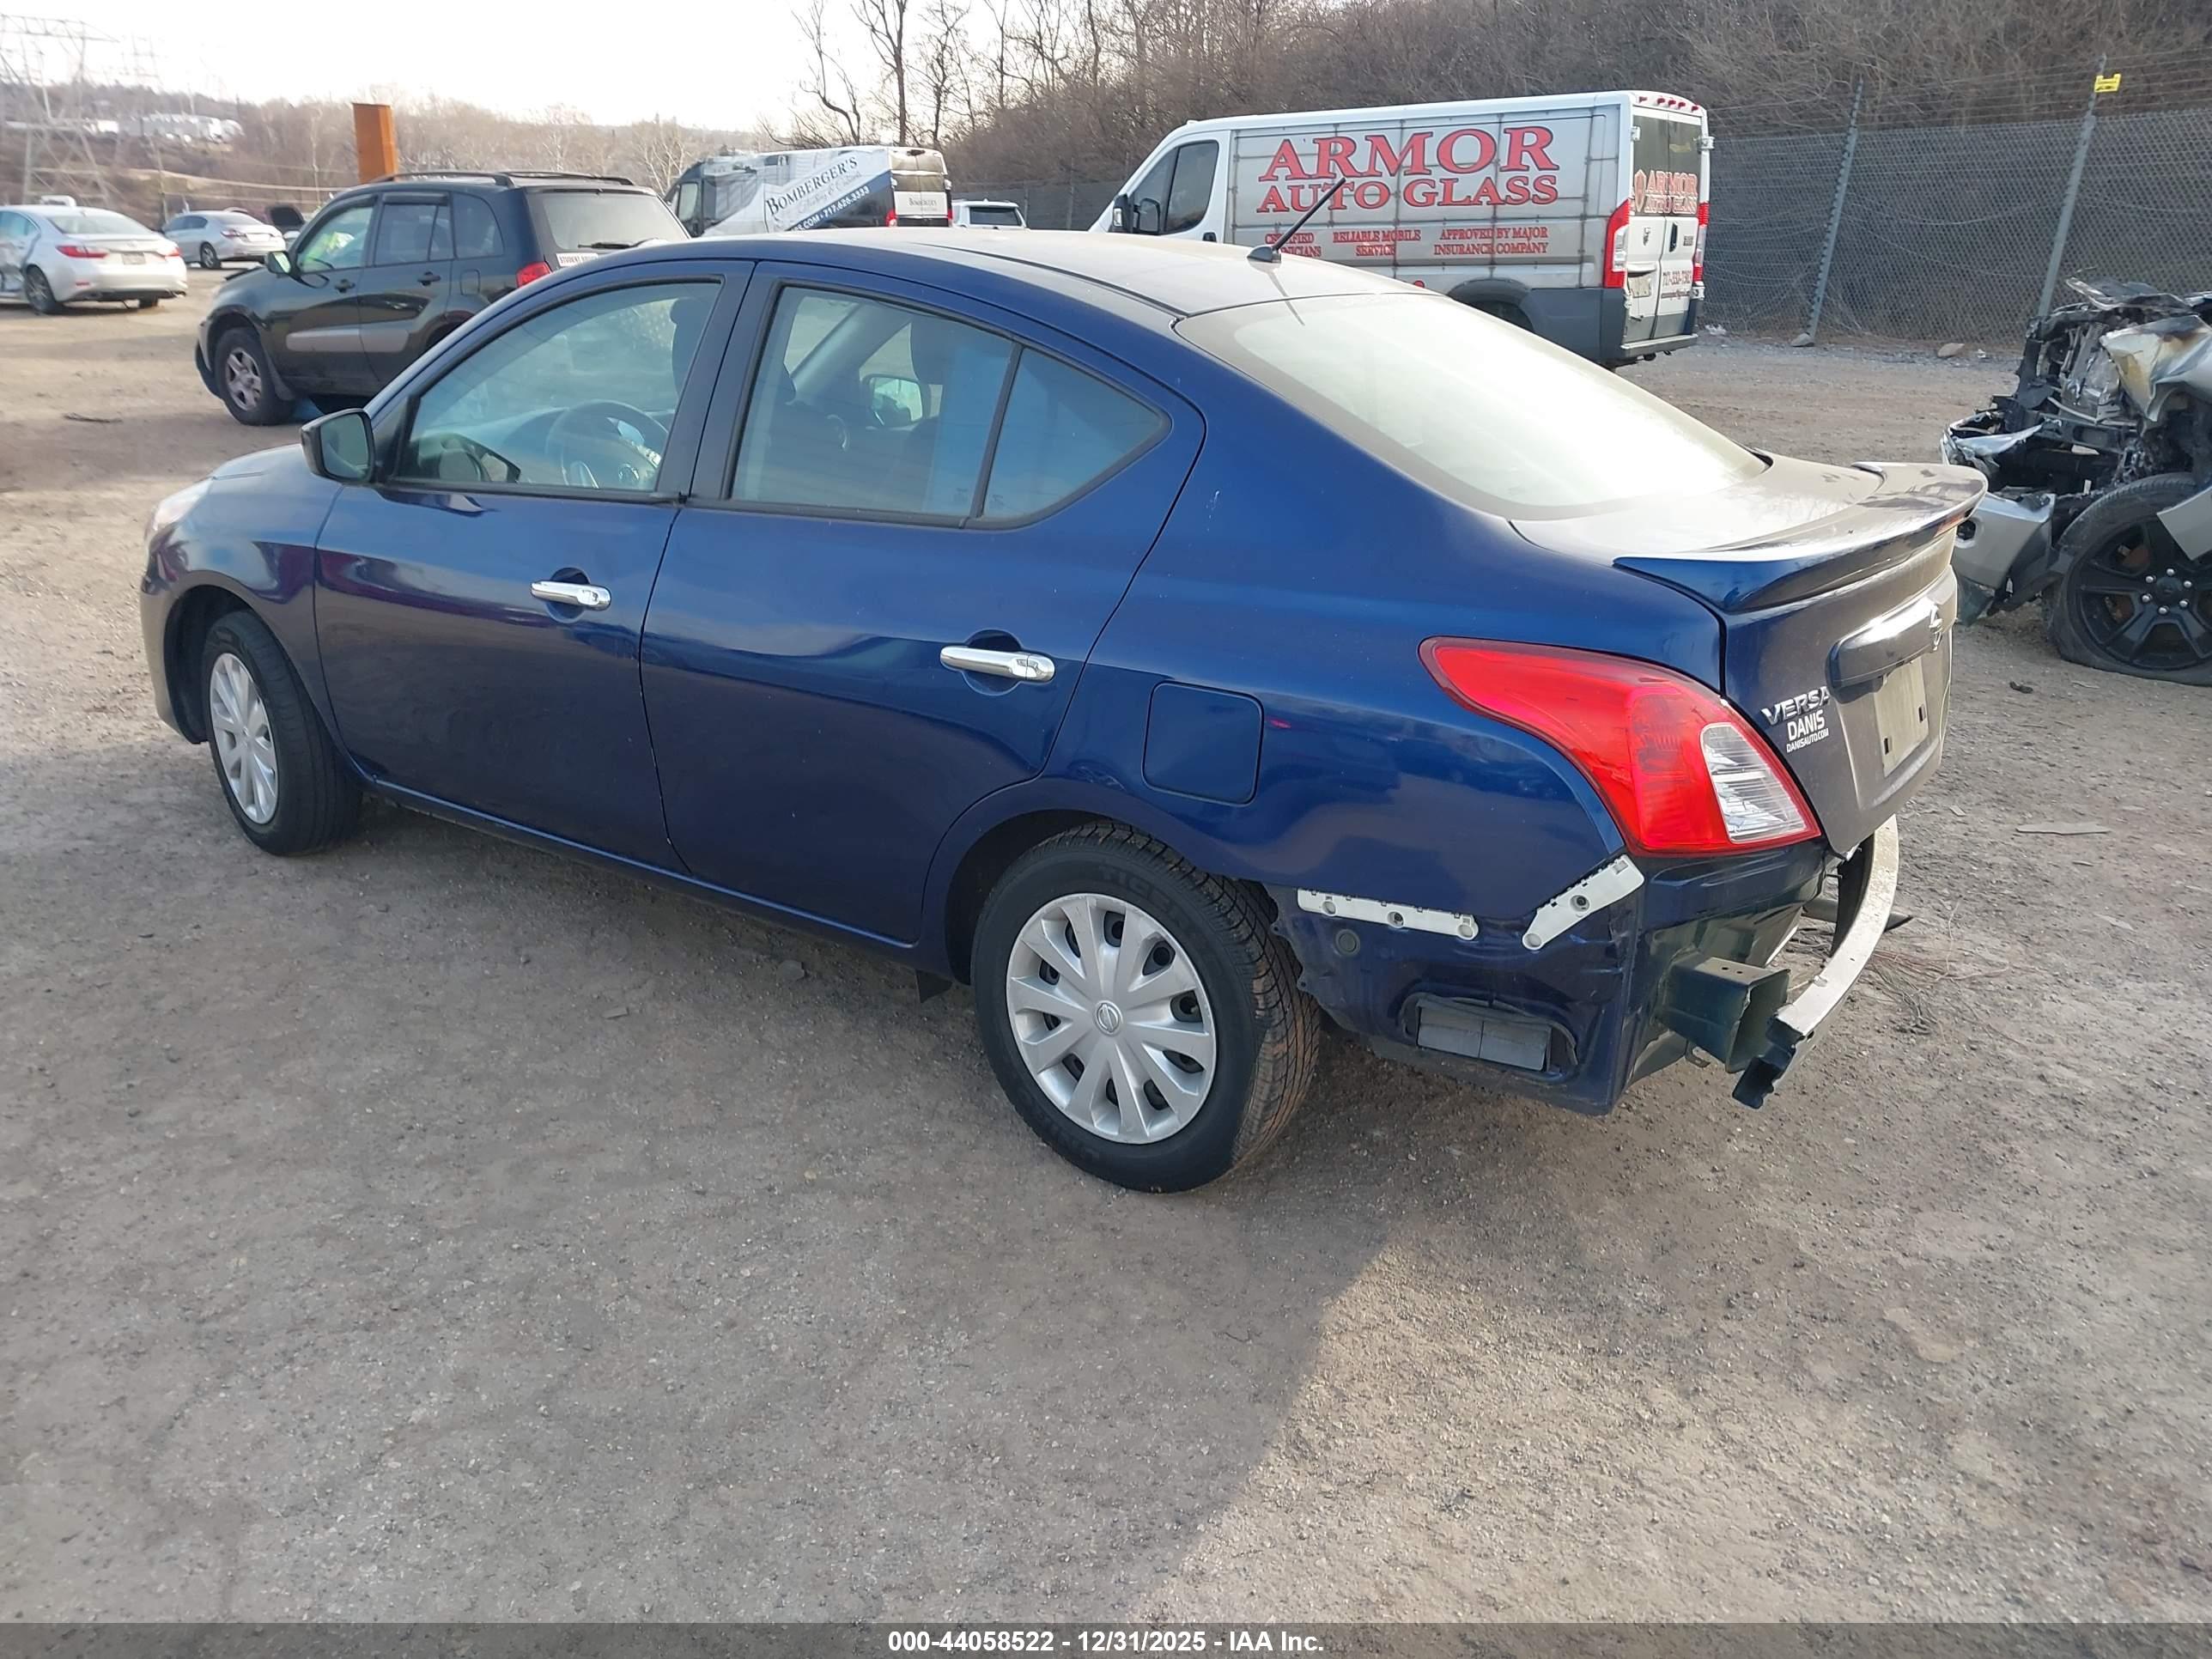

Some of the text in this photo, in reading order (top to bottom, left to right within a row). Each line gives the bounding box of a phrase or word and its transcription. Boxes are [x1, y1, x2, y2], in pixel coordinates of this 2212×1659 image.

[1258, 125, 1559, 181] ARMOR
[765, 156, 858, 215] BOMBERGER'S
[1256, 174, 1559, 212] AUTO GLASS
[1647, 170, 1698, 195] ARMOR
[1332, 229, 1421, 243] RELIABLE MOBILE
[1440, 227, 1549, 240] APPROVED BY MAJOR
[1355, 244, 1397, 257] SERVICE
[1433, 241, 1549, 256] INSURANCE COMPANY
[1761, 685, 1830, 726] VERSA
[1787, 709, 1825, 741] DANIS
[1786, 727, 1829, 753] DANISAUTO.COM
